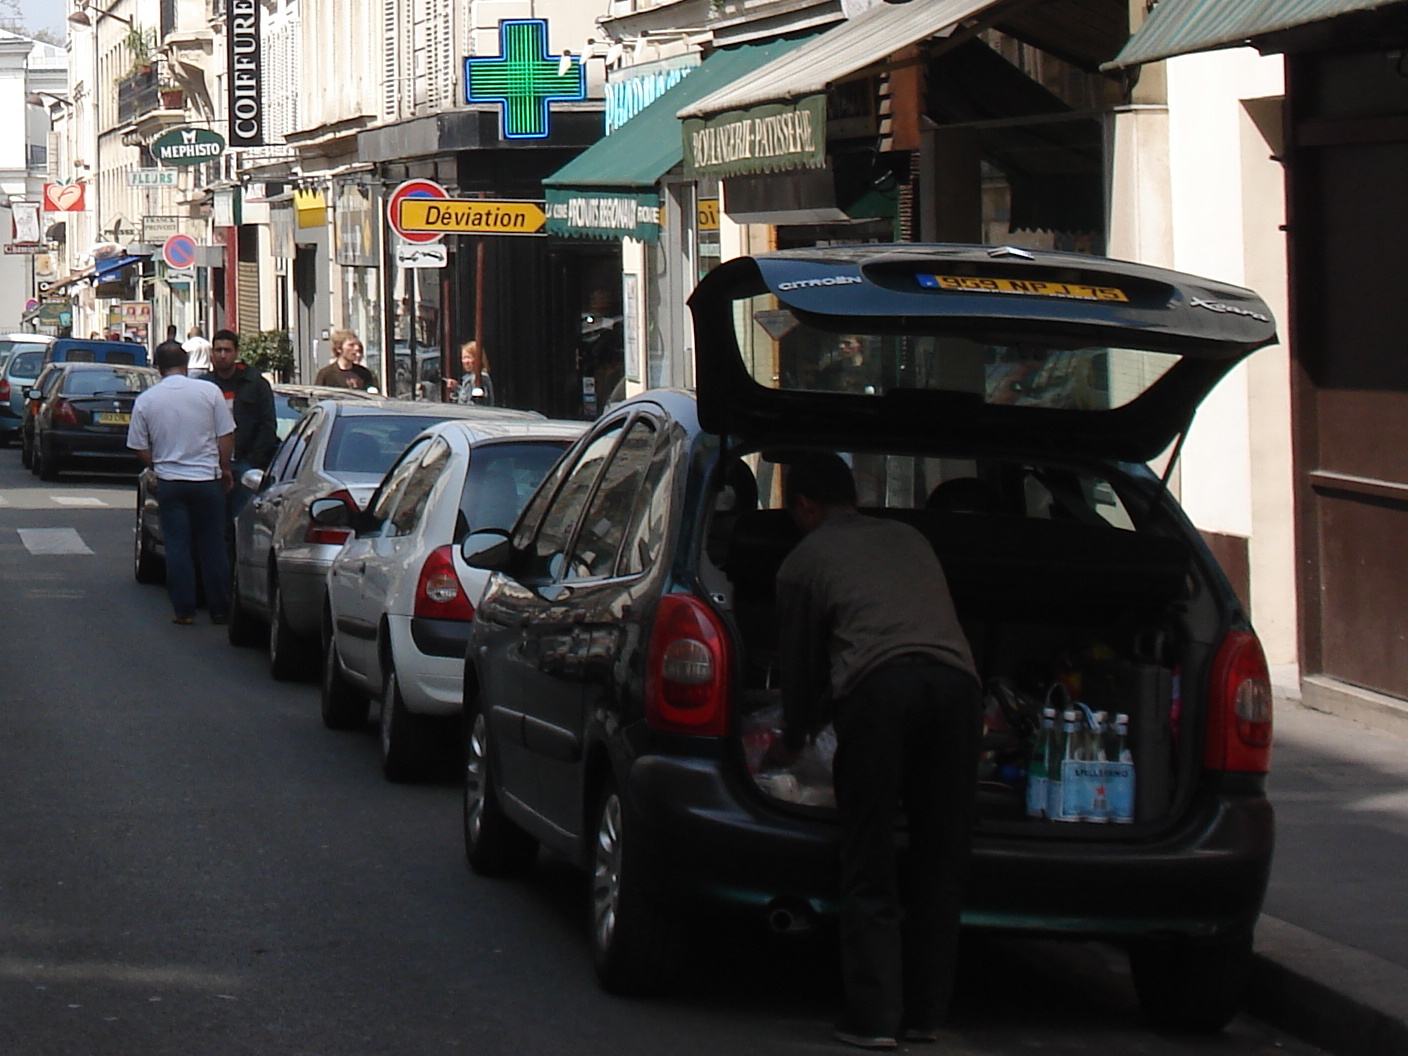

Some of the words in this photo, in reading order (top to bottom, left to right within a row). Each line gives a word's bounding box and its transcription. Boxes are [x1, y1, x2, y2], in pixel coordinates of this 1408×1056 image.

[233, 0, 258, 139] COIFFURE
[160, 143, 220, 159] MEPHISTO
[132, 173, 173, 184] FLEURS
[425, 206, 525, 228] Déviation
[778, 275, 863, 291] CITROËN
[1081, 286, 1122, 301] 75
